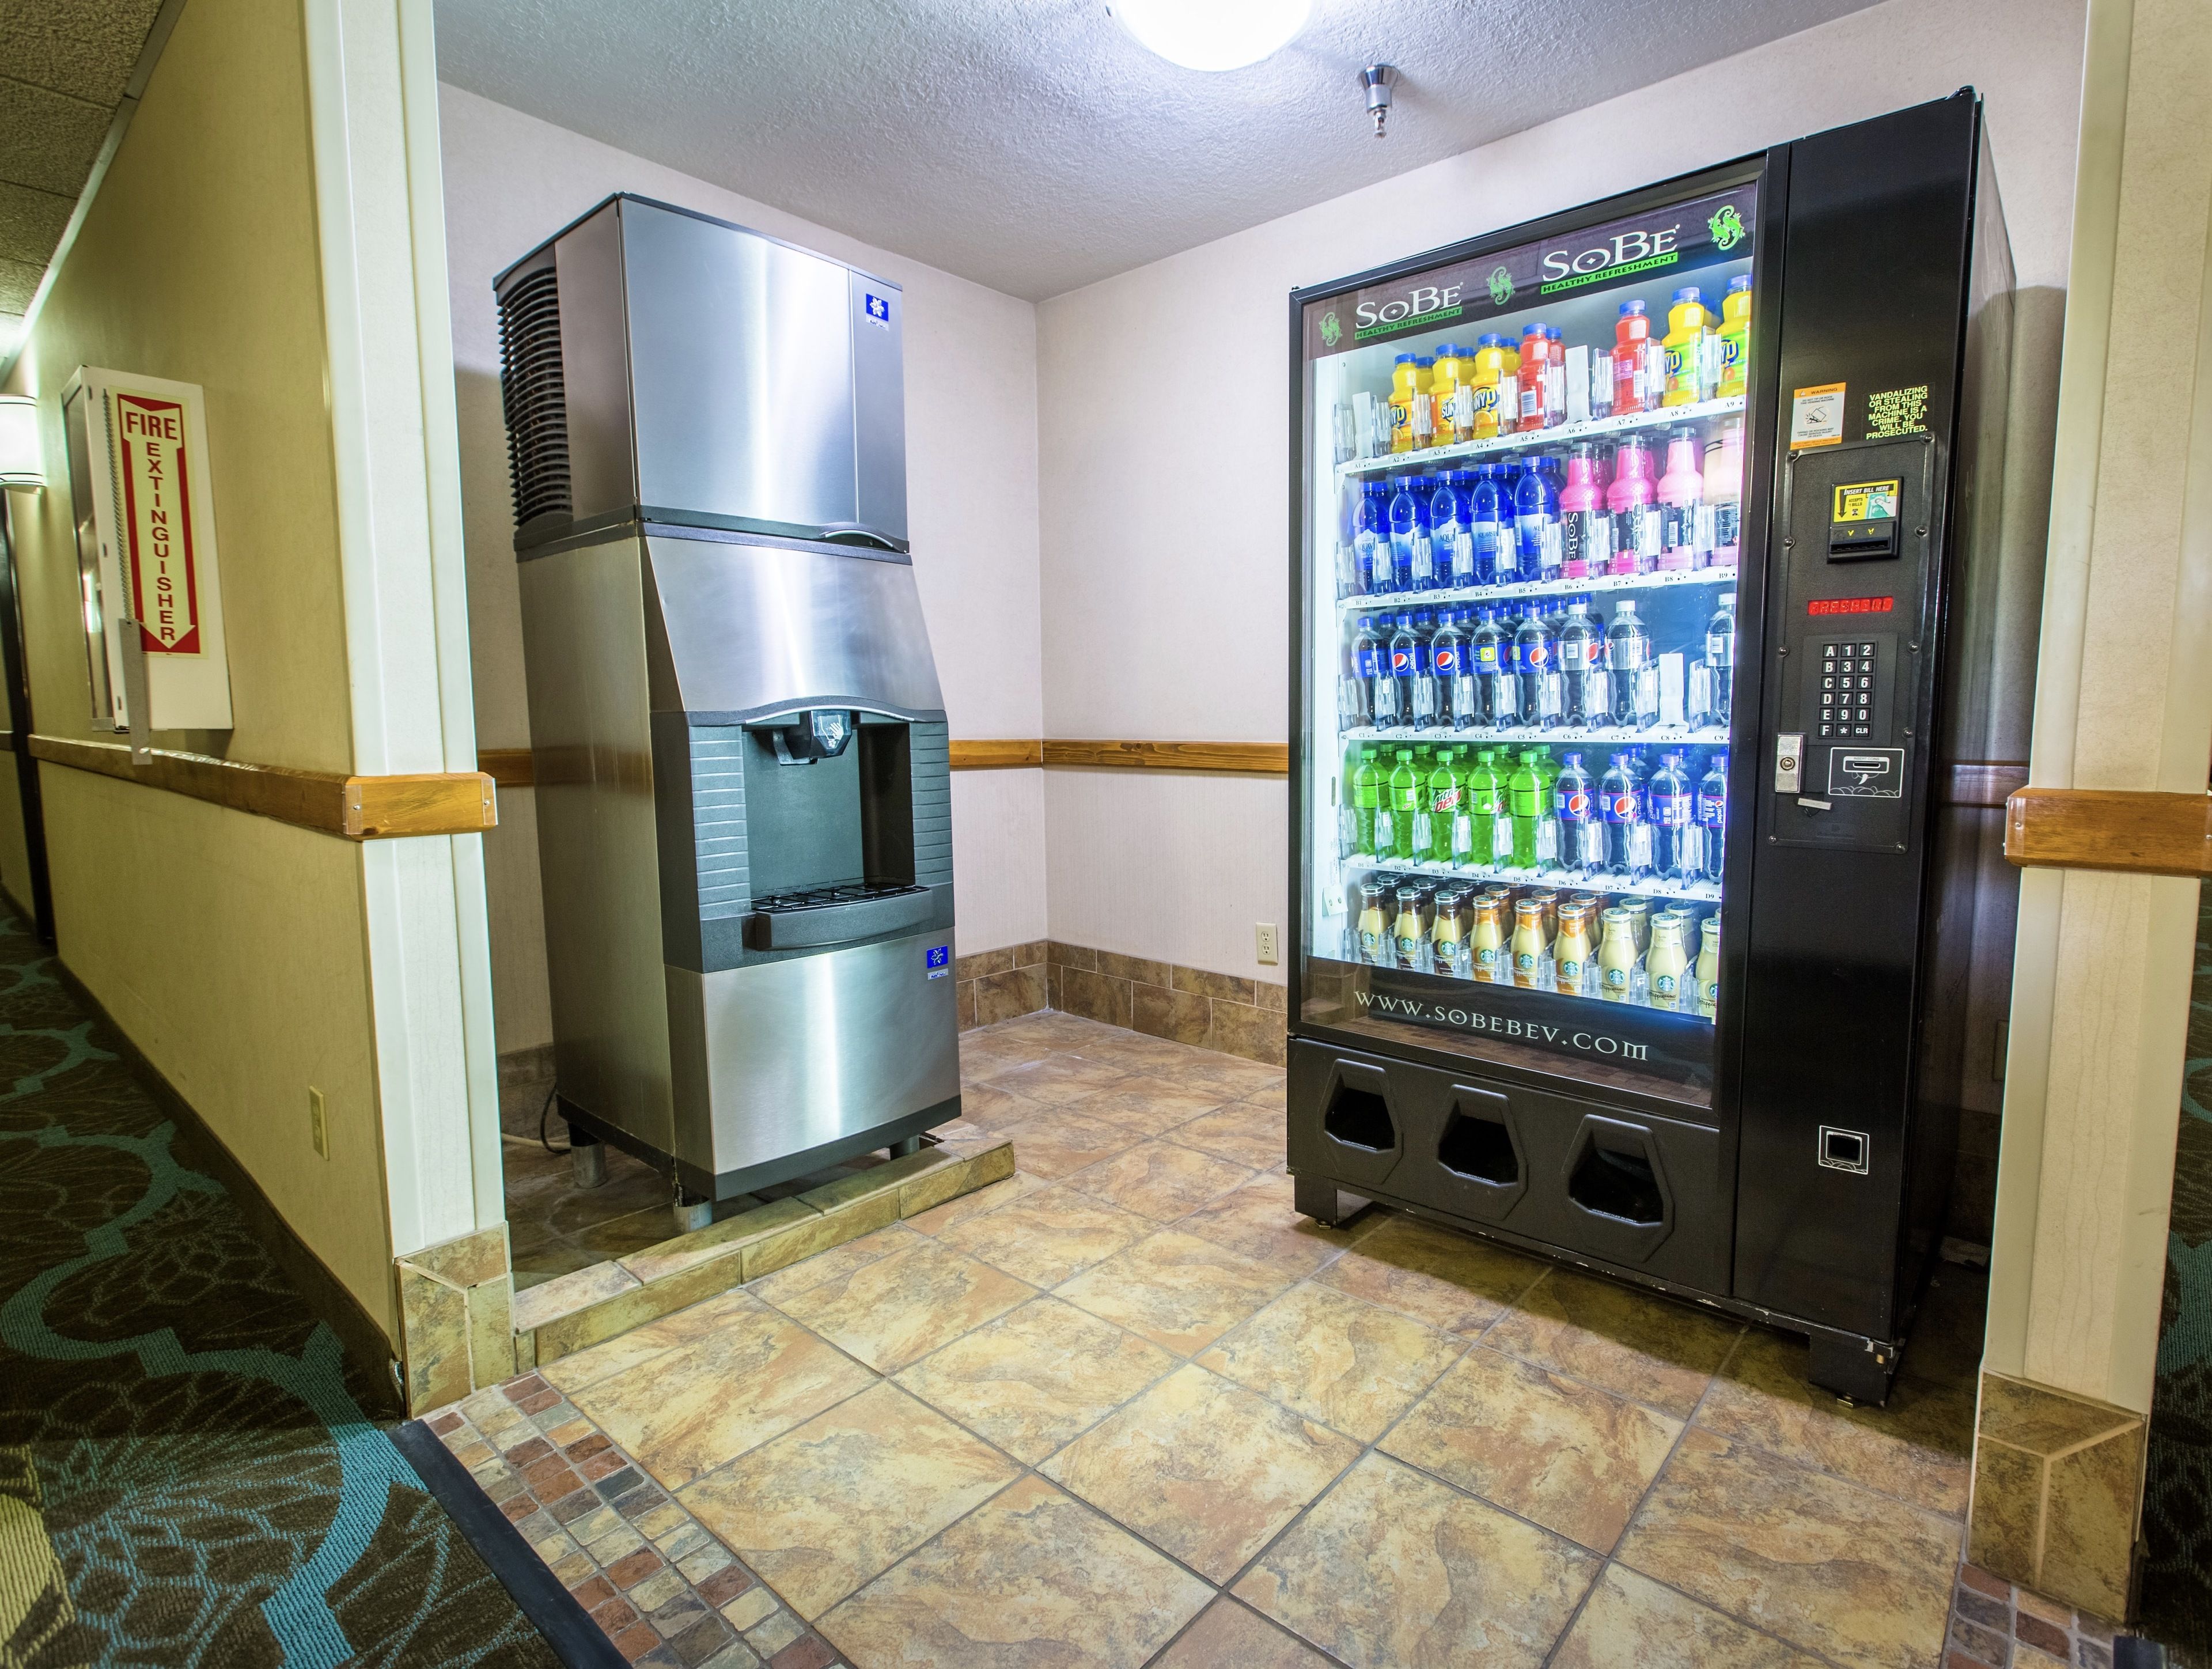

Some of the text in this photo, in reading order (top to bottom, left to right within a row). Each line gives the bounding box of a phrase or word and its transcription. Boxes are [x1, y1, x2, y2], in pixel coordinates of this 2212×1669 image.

[1543, 254, 1676, 292] HEALTHY REFRESHMENT
[1357, 309, 1460, 338] HEALTHY REFRESHMENT
[1869, 385, 1927, 401] VANDALIZING
[1884, 392, 1927, 405] STEALING
[1874, 400, 1922, 413] FROM THIS
[1868, 408, 1908, 421] MACHINE
[1872, 412, 1923, 426] CRIME. YOU
[126, 411, 177, 440] FIRE
[1880, 422, 1900, 431] WILL
[1866, 425, 1928, 440] PROSECUTED.
[146, 442, 175, 641] EXTINGUISHER
[1825, 645, 1871, 656] A 1 2
[1825, 661, 1869, 672] B 3 4
[1824, 678, 1868, 688] C 5 6
[1823, 694, 1867, 704] D 7 8
[1823, 709, 1866, 720] E 9 0
[1822, 725, 1830, 736] F
